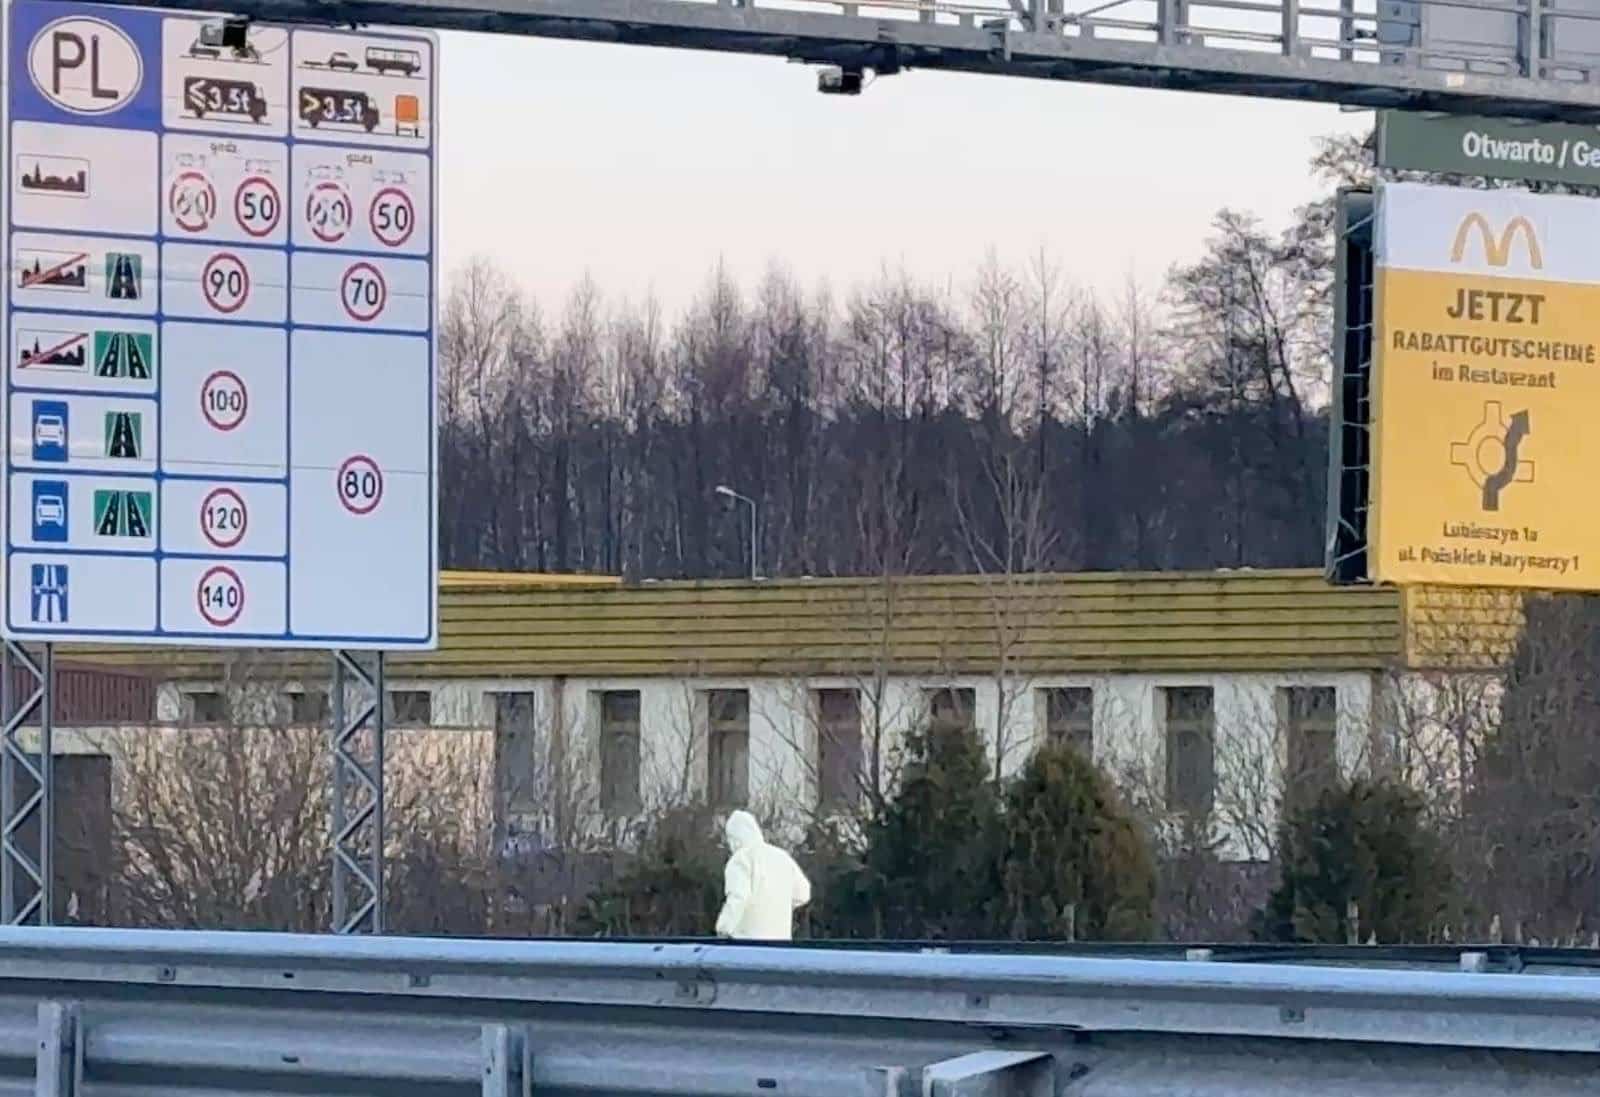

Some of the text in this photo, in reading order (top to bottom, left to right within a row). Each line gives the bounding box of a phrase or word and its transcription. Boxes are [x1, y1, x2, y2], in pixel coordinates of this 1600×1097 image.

[53, 32, 118, 99] PL
[243, 193, 274, 221] 50
[377, 205, 408, 231] 50
[210, 269, 242, 297] 90
[352, 279, 379, 306] 70
[1447, 288, 1545, 324] JETZT
[1393, 330, 1595, 364] RABATTGUTSCHEINE
[1432, 361, 1556, 388] im Restaurant
[208, 389, 241, 412] 100
[345, 472, 376, 498] 80
[208, 507, 241, 529] 120
[204, 585, 238, 608] 140
